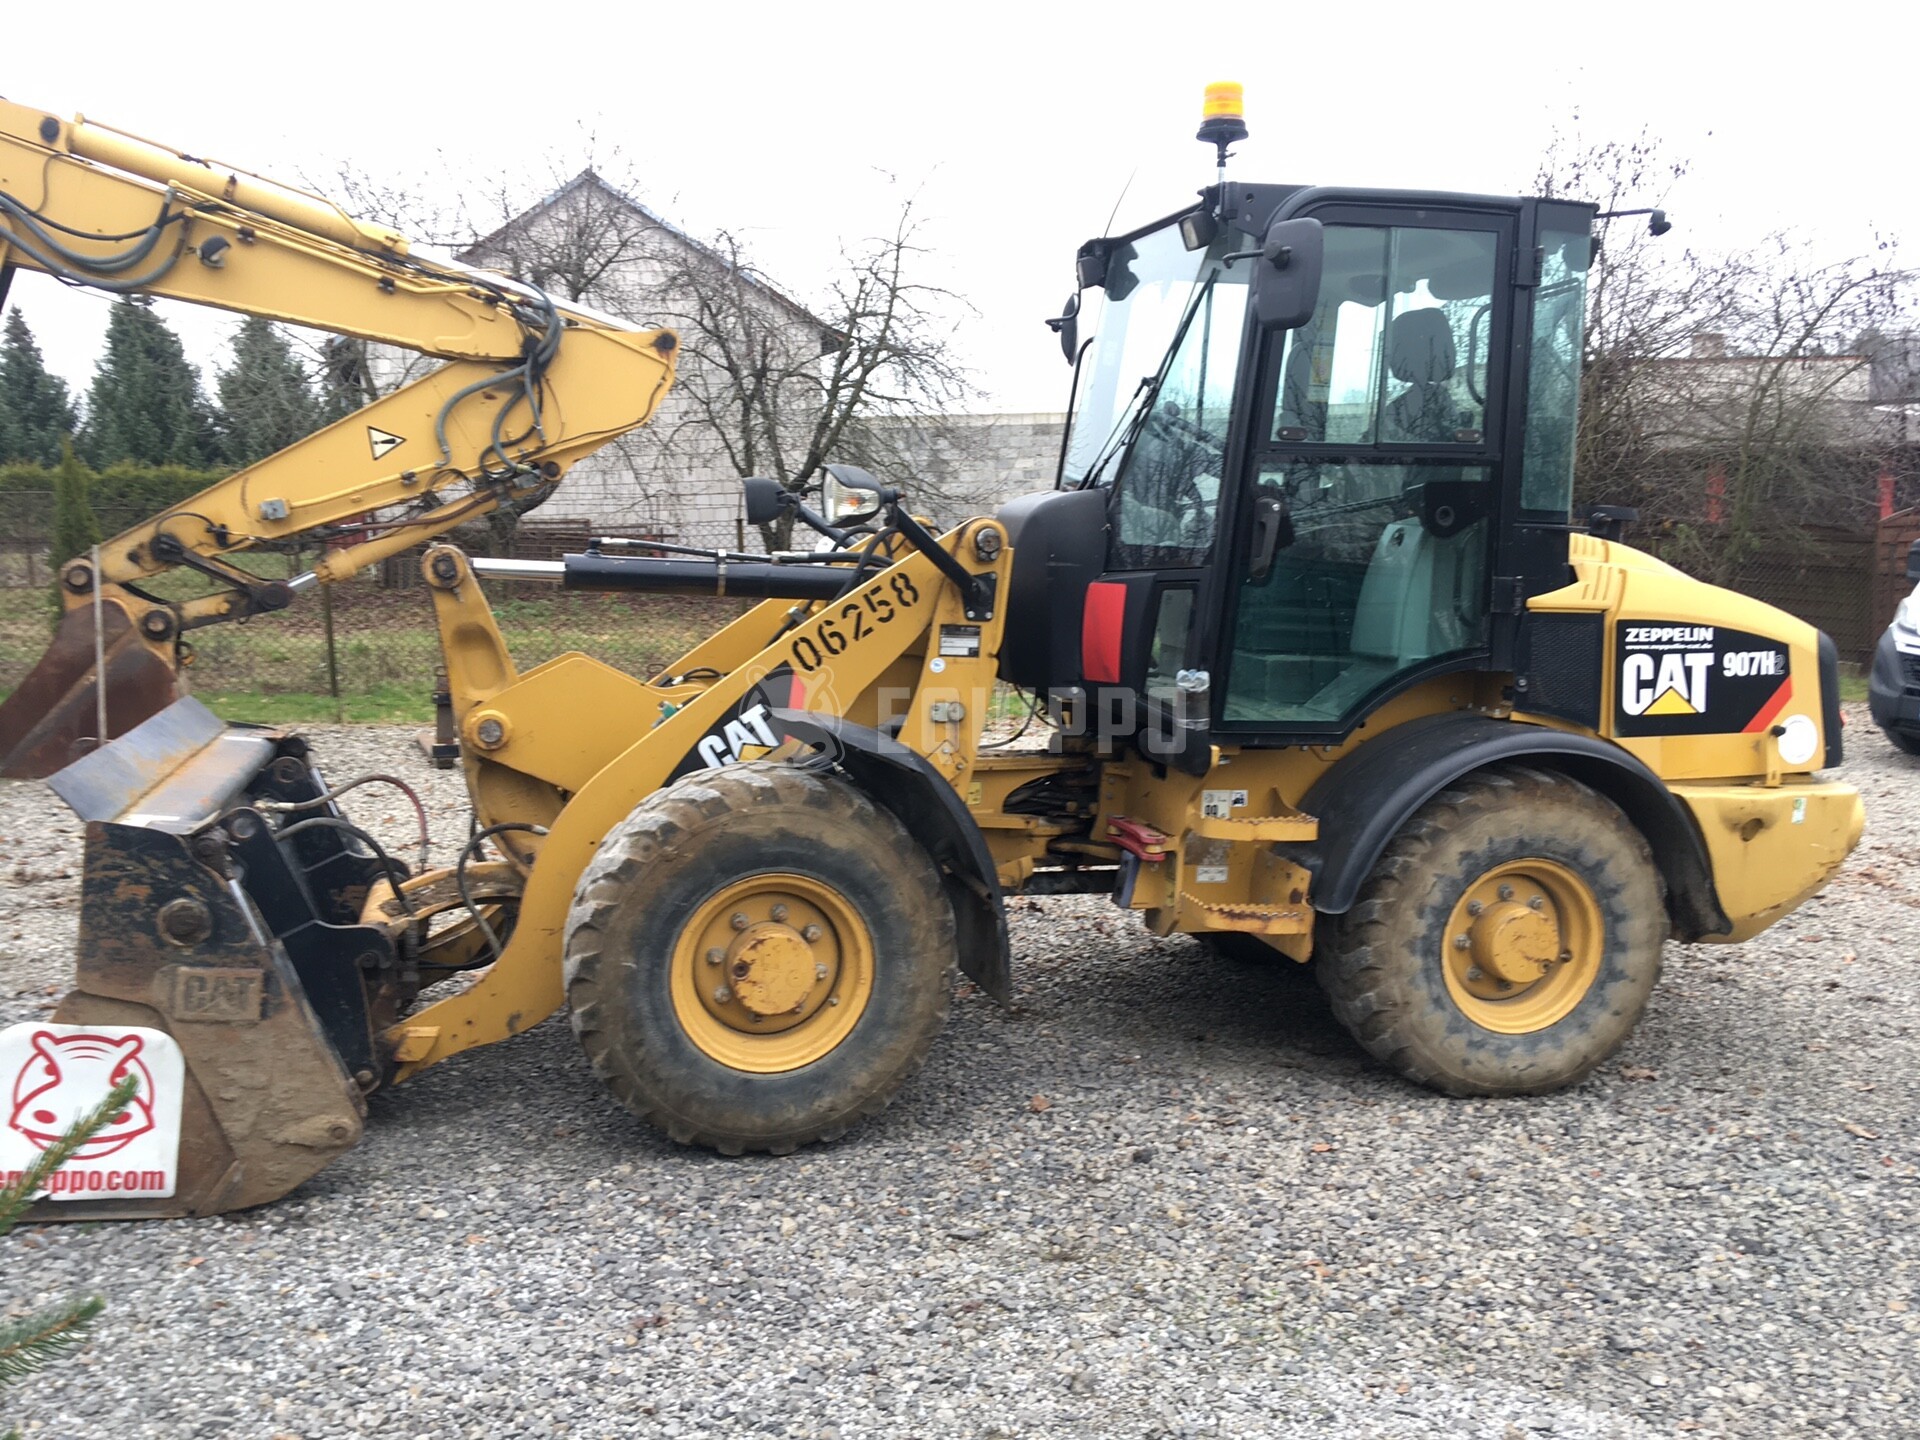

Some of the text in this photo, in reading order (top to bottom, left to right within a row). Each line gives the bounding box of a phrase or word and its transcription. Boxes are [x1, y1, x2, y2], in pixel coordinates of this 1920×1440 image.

[791, 572, 919, 672] 06258
[1625, 627, 1714, 643] ZEPPELIN
[1622, 652, 1715, 716] CAT
[697, 703, 780, 769] CAT
[184, 975, 256, 1013] CAT
[0, 1170, 165, 1194] qppo.com
